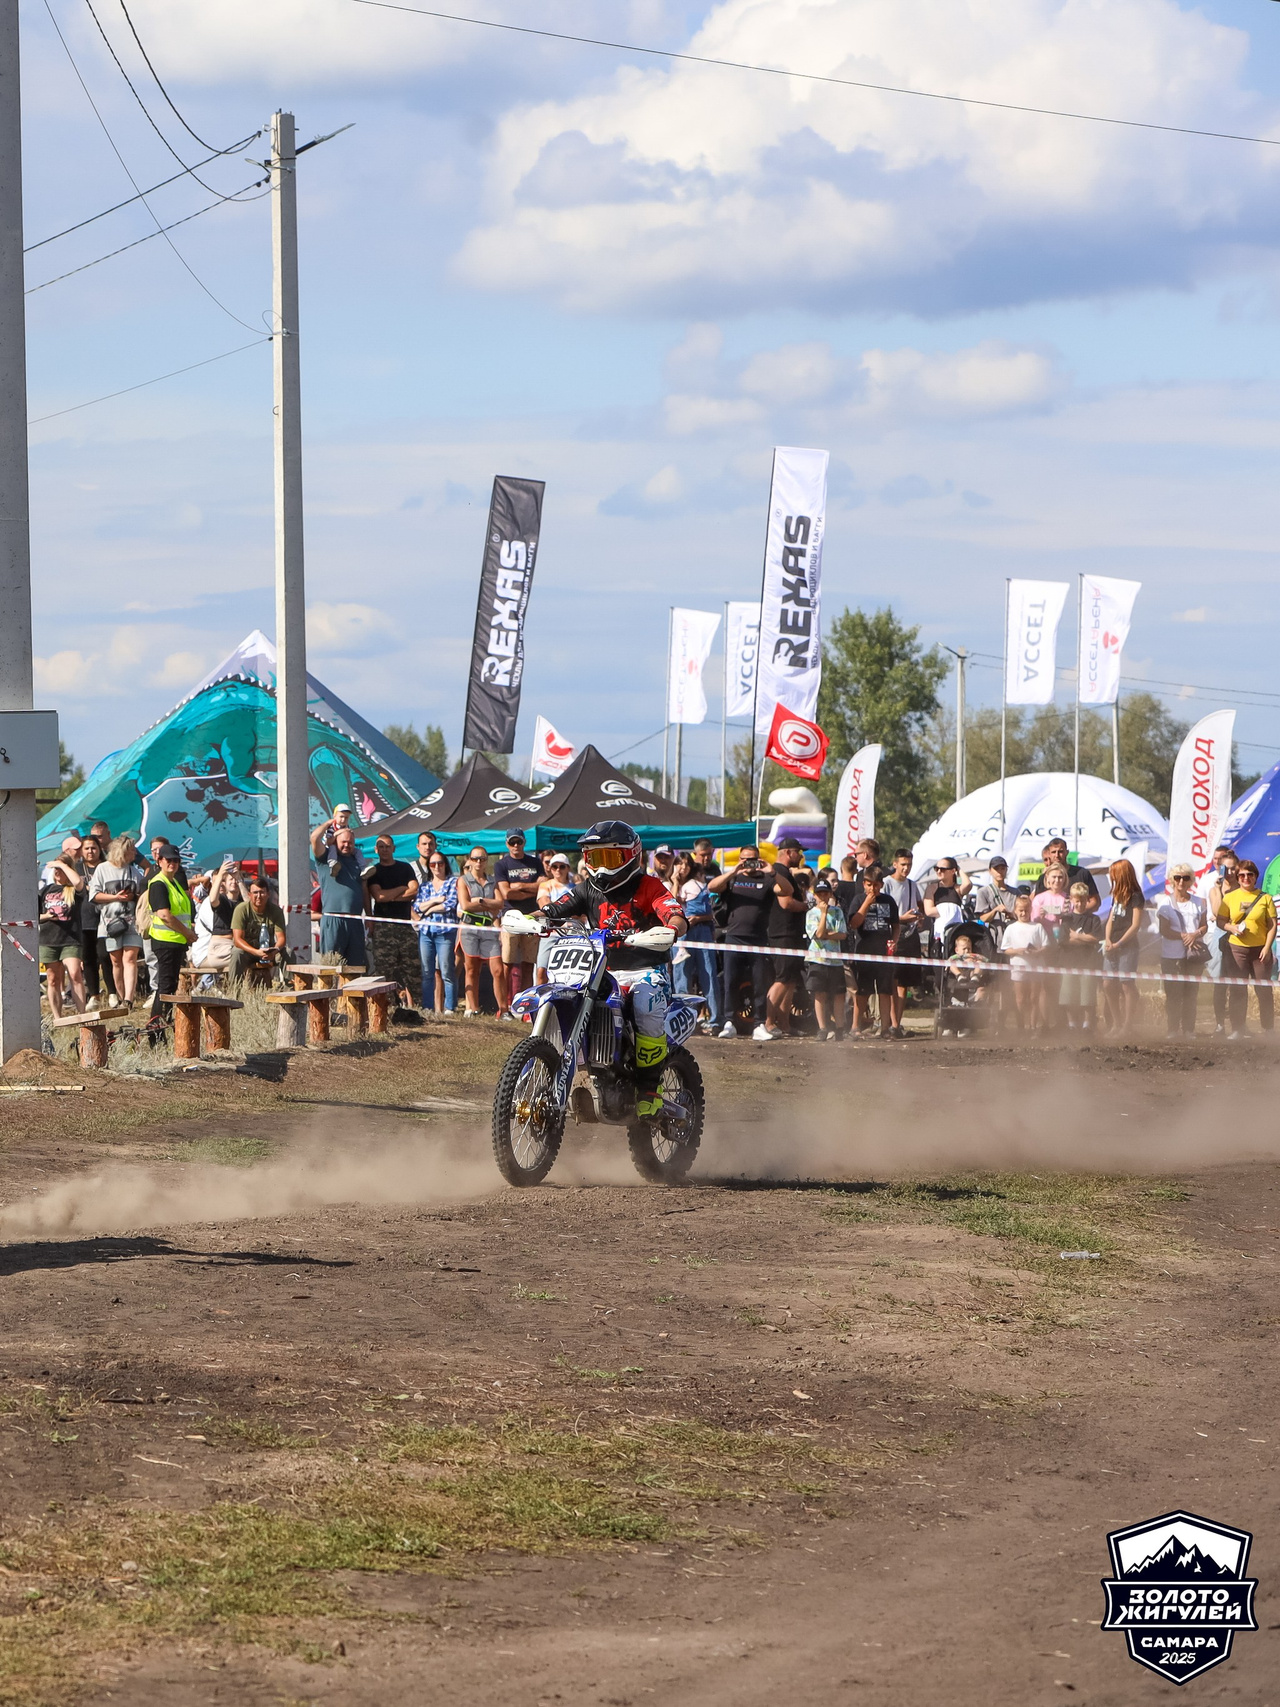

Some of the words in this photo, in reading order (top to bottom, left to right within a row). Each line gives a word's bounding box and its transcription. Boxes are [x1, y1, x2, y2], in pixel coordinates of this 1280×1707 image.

[772, 515, 812, 669] REXAS
[480, 539, 527, 687] REXAS
[408, 807, 432, 819] OTO
[519, 801, 541, 812] OTO
[596, 798, 657, 810] CFMOTO
[847, 768, 864, 857] УСОХОД
[1191, 737, 1215, 859] РУСОХОД
[548, 948, 601, 971] 999
[669, 1006, 695, 1041] 999
